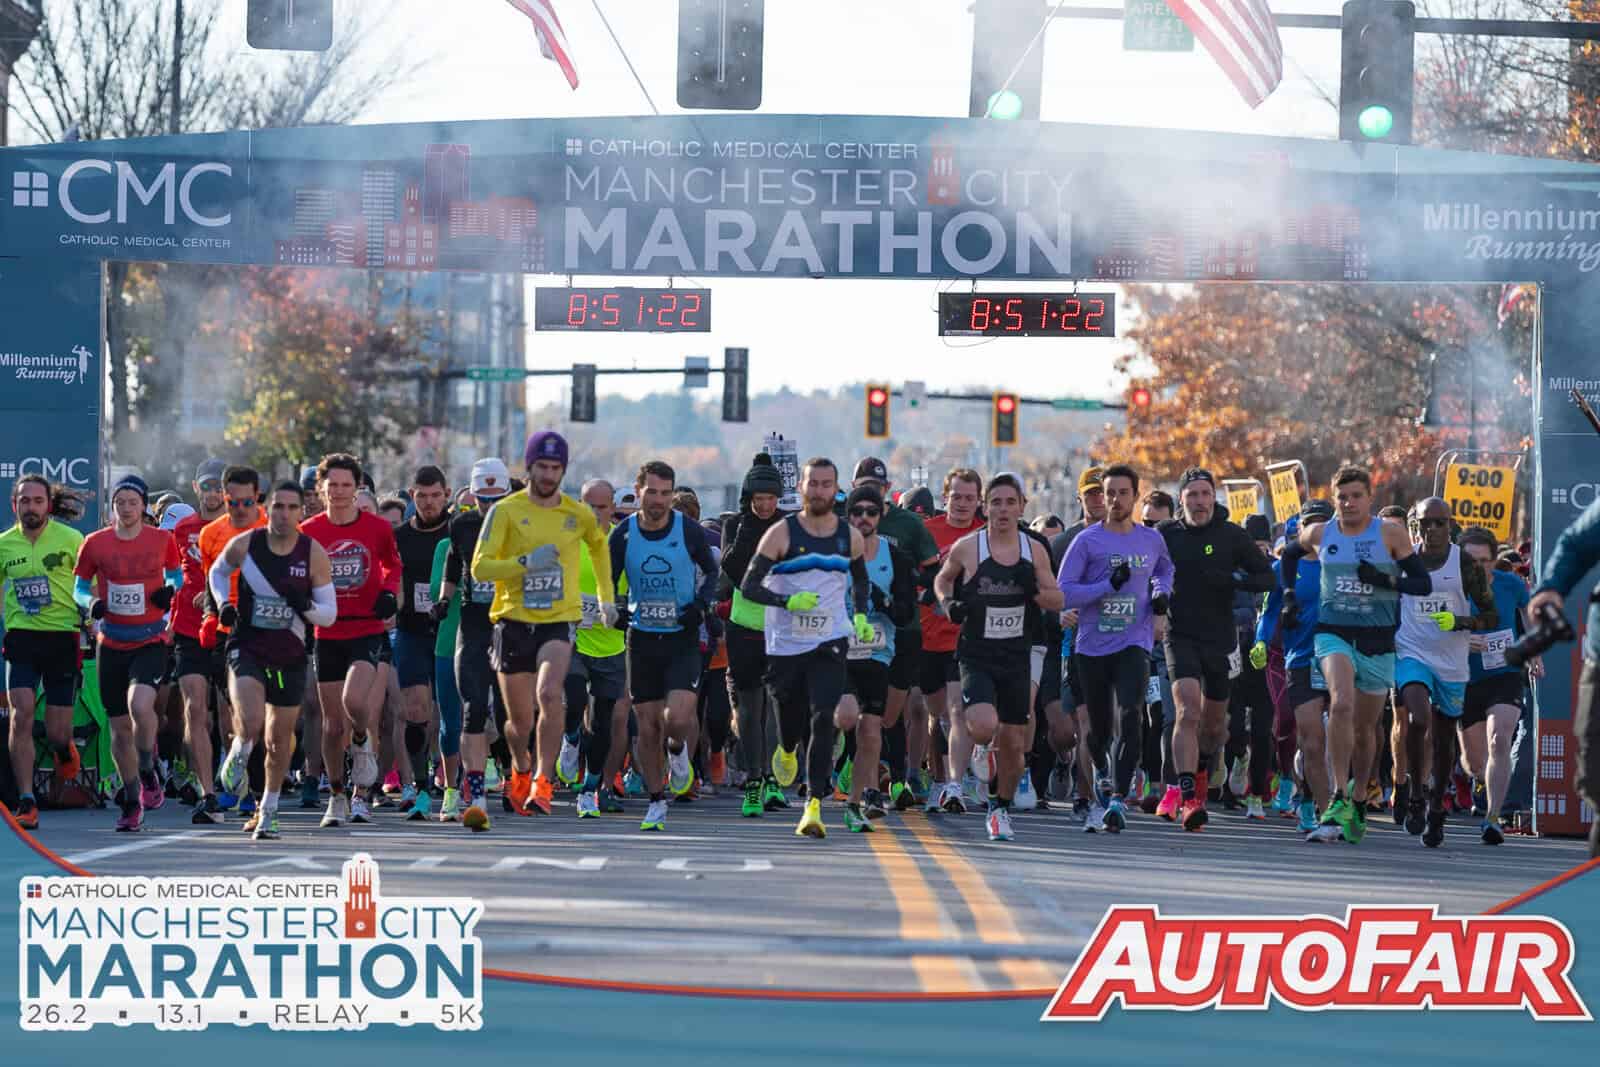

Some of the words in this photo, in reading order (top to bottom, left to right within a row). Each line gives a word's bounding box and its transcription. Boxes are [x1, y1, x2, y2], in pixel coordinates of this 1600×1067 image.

[588, 139, 701, 158] CATHOLIC
[713, 141, 817, 159] MEDICAL
[824, 142, 918, 160] CENTER
[58, 159, 232, 227] CMC
[565, 166, 916, 205] MANCHESTER
[965, 169, 1073, 206] CITY
[59, 234, 119, 246] CATHOLIC
[124, 236, 179, 247] MEDICAL
[182, 238, 231, 248] CENTER
[564, 207, 1072, 274] MARATHON
[1464, 233, 1600, 272] Running
[0, 353, 77, 367] Millennium
[15, 367, 77, 384] Running
[19, 457, 89, 485] CMC
[1457, 466, 1503, 489] 9:00
[1230, 492, 1254, 512] 11:00
[1450, 497, 1505, 520] 10:00
[524, 575, 562, 591] 2574
[640, 577, 675, 588] FLOAT
[16, 584, 49, 598] 2496
[111, 592, 141, 605] 1229
[641, 607, 677, 618] 2464
[1103, 602, 1134, 615] 2271
[799, 615, 827, 628] 1157
[989, 615, 1022, 628] 1407
